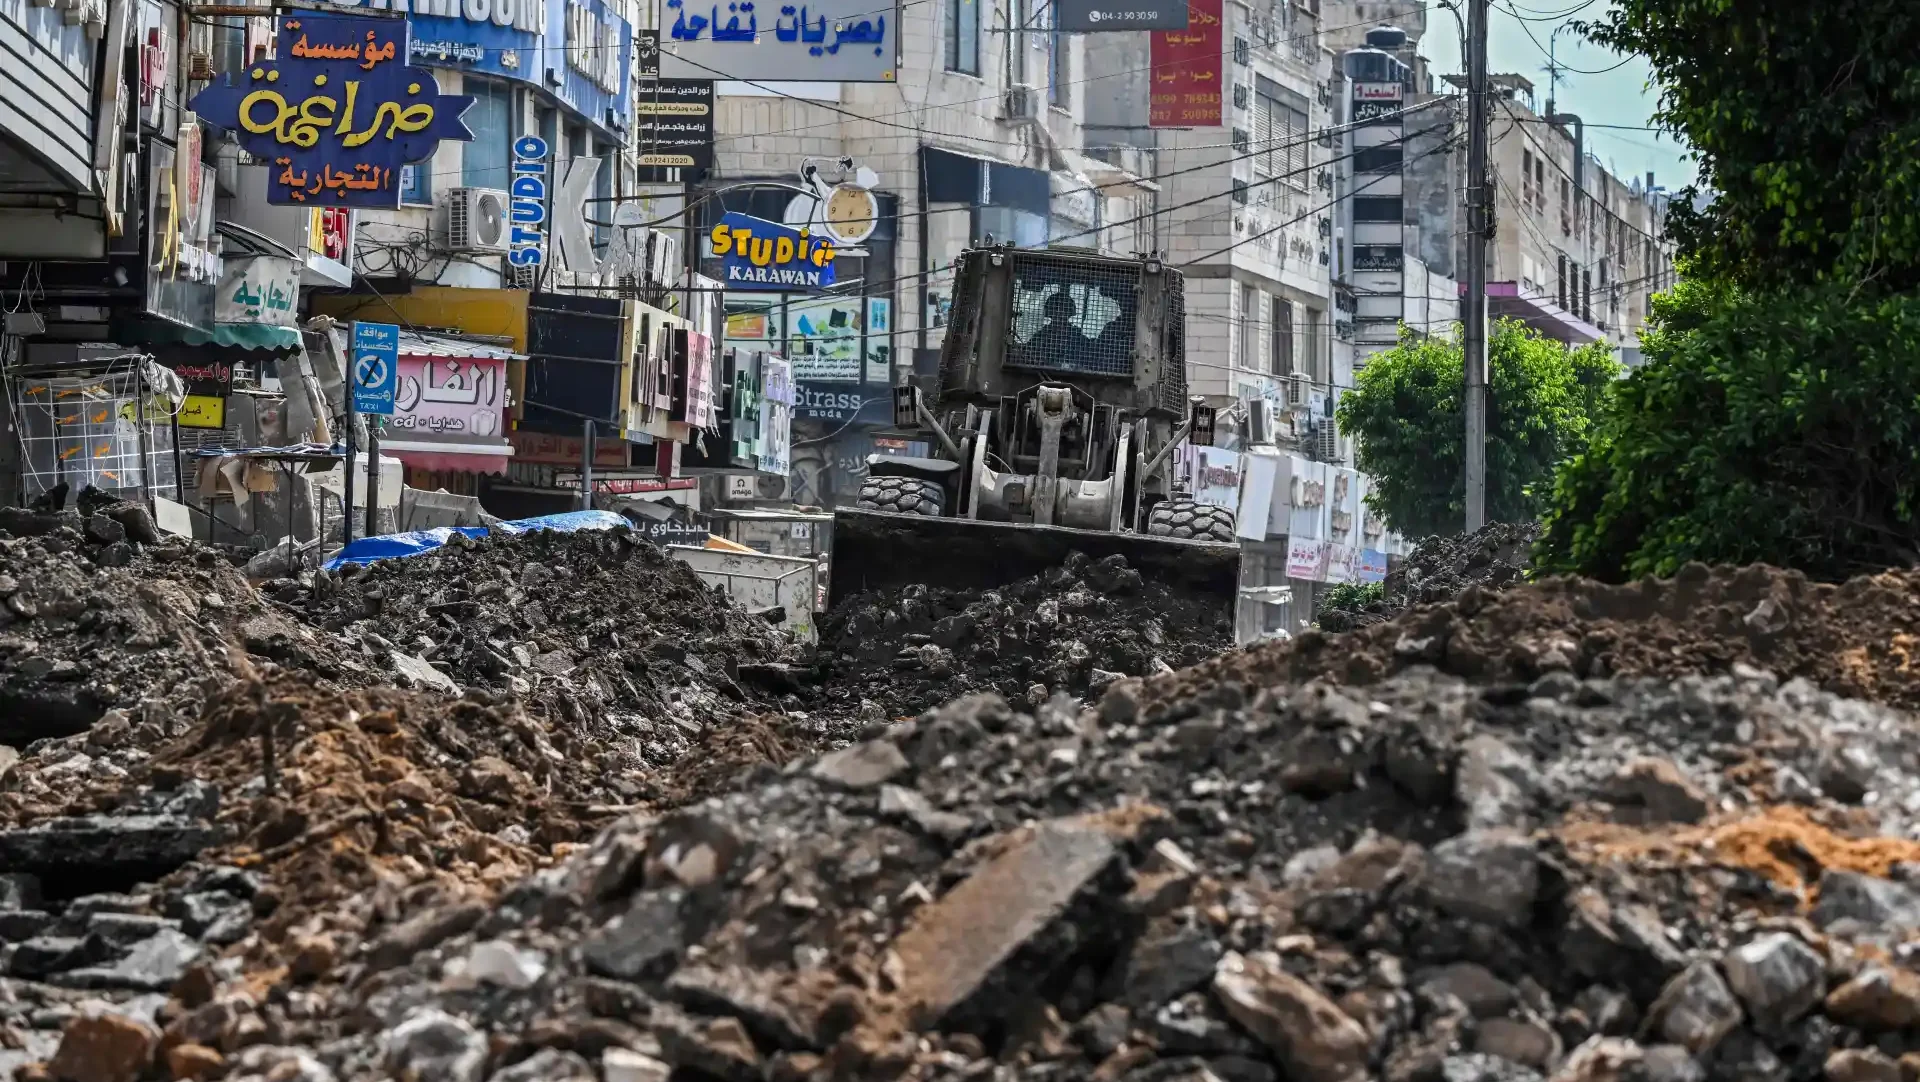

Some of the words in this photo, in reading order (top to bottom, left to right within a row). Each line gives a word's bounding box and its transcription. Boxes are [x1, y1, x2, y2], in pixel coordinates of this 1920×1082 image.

[667, 0, 757, 42] تفاحة
[775, 4, 886, 57] بصريات
[285, 20, 396, 70] مؤسسة
[238, 68, 435, 148] ضراغمة
[275, 157, 391, 202] التجارية
[508, 134, 548, 267] STUDIO
[728, 265, 821, 286] KARAWAN
[359, 326, 389, 341] مواقف
[354, 389, 383, 400] تكسيا
[795, 384, 861, 410] Strass
[359, 402, 380, 411] TAXI
[809, 409, 842, 418] moda
[393, 414, 417, 429] cd
[429, 414, 465, 432] هدايا
